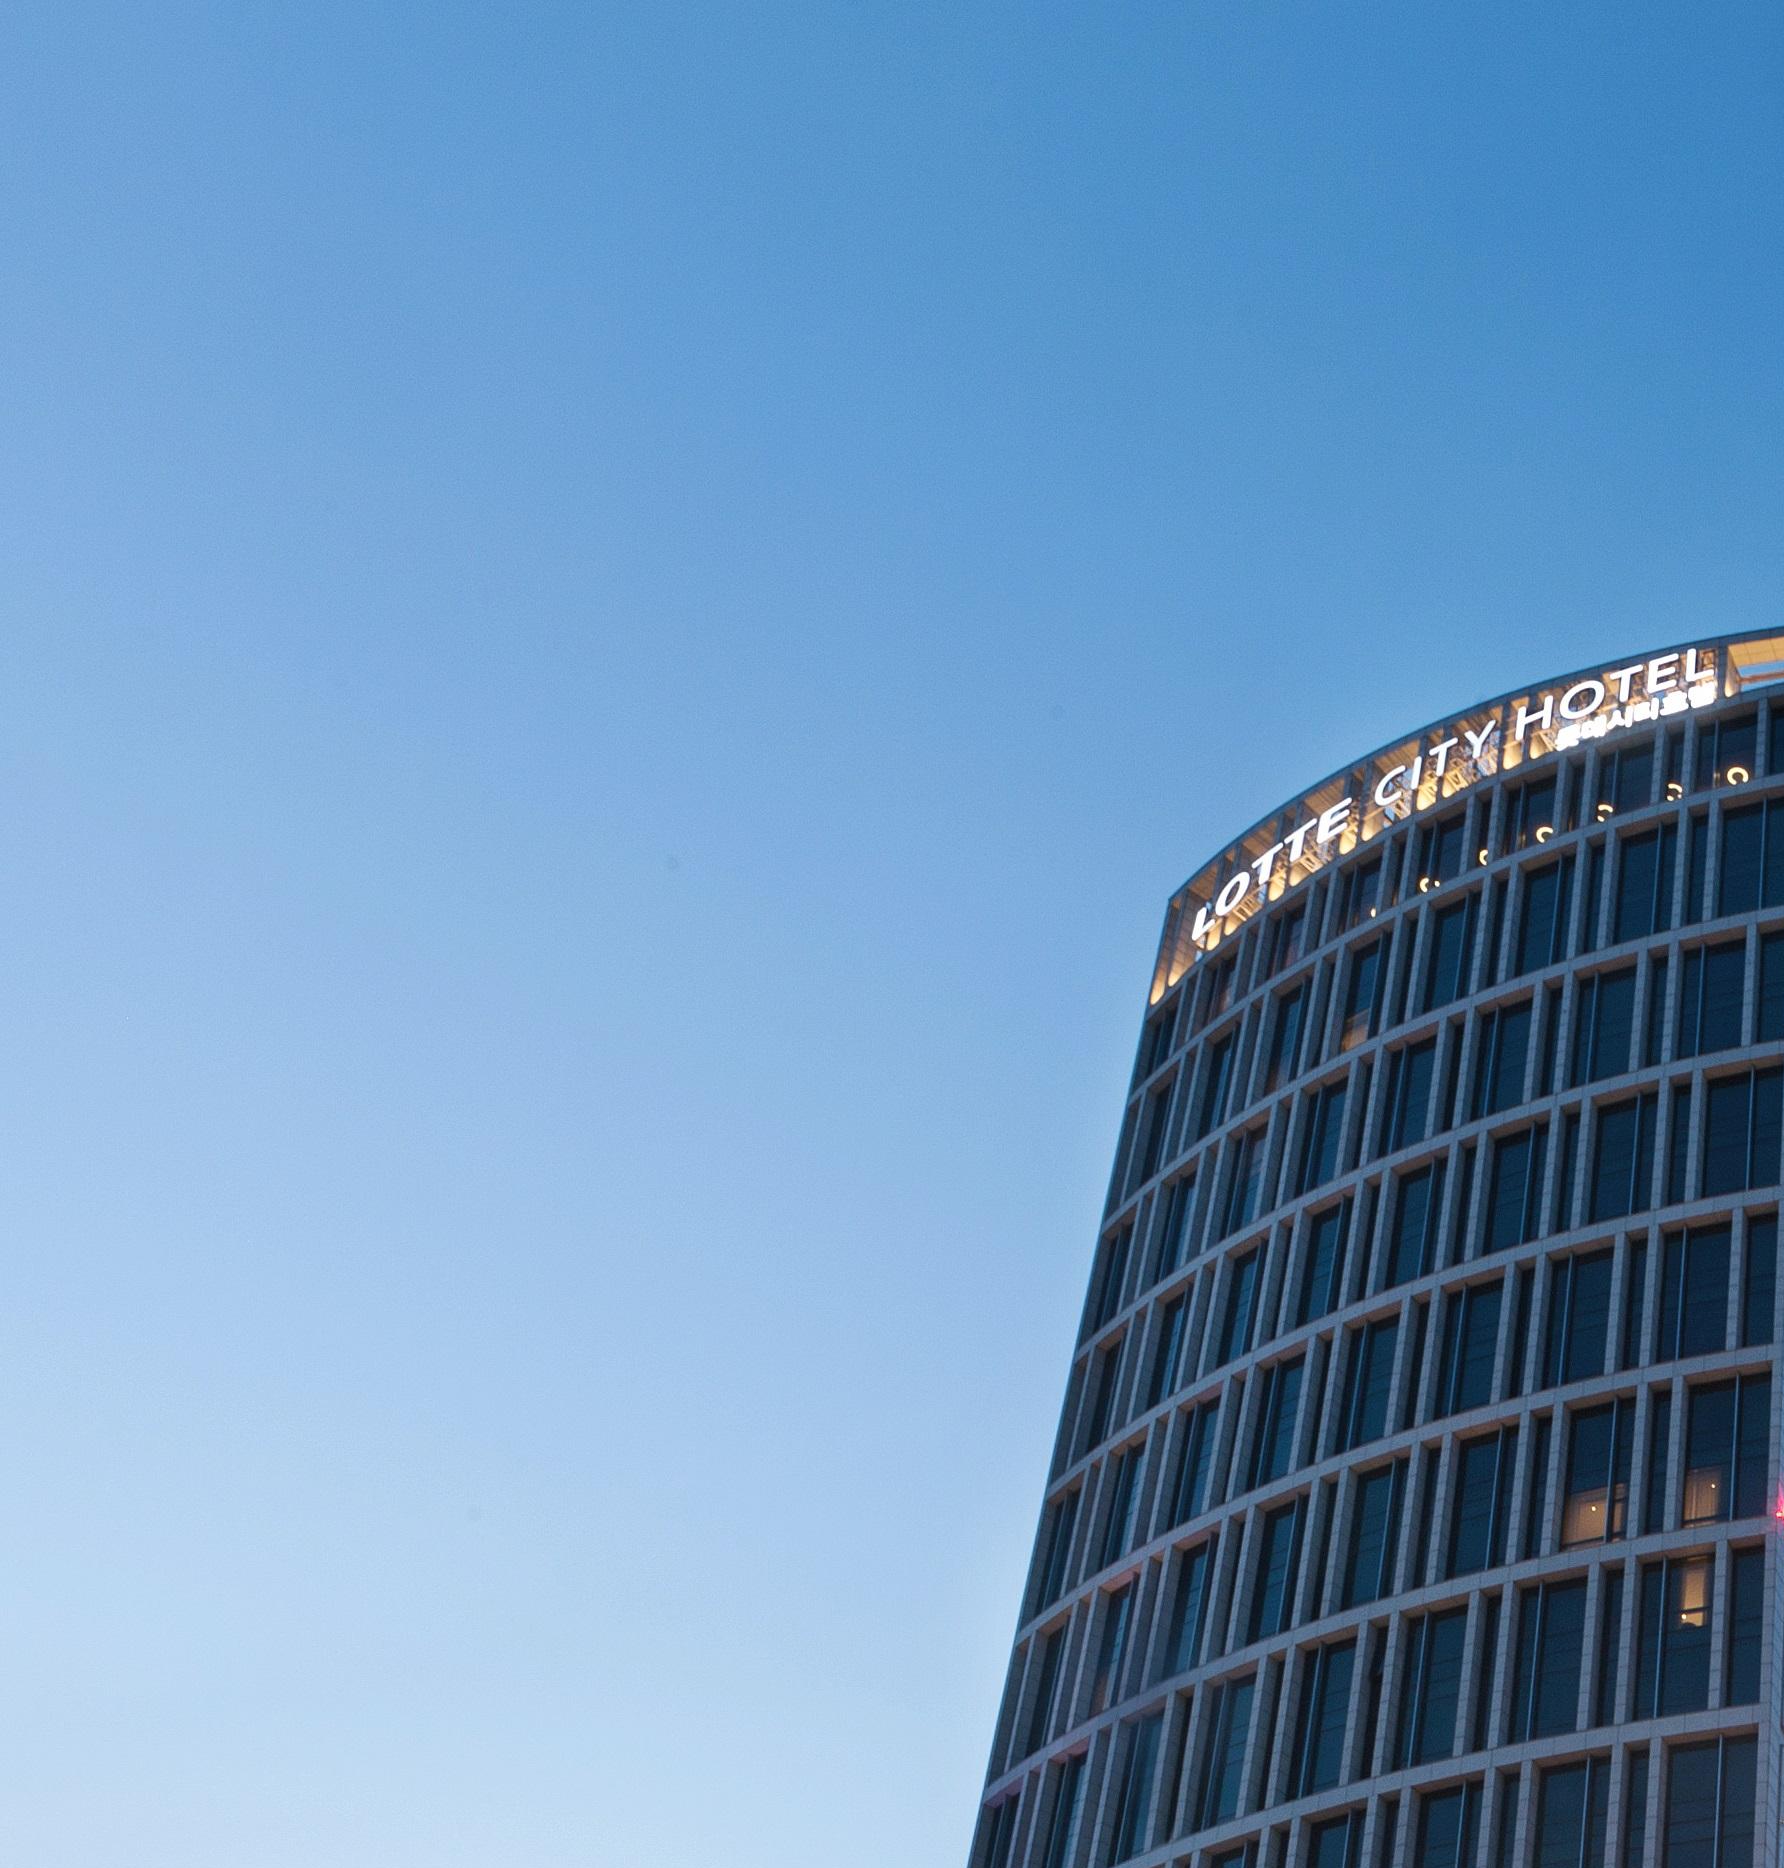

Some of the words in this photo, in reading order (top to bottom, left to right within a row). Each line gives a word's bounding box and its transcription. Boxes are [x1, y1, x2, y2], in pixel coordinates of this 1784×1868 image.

[1191, 796, 1354, 941] LOTTE
[1374, 719, 1496, 807] CITY
[1515, 646, 1716, 740] HOTEL
